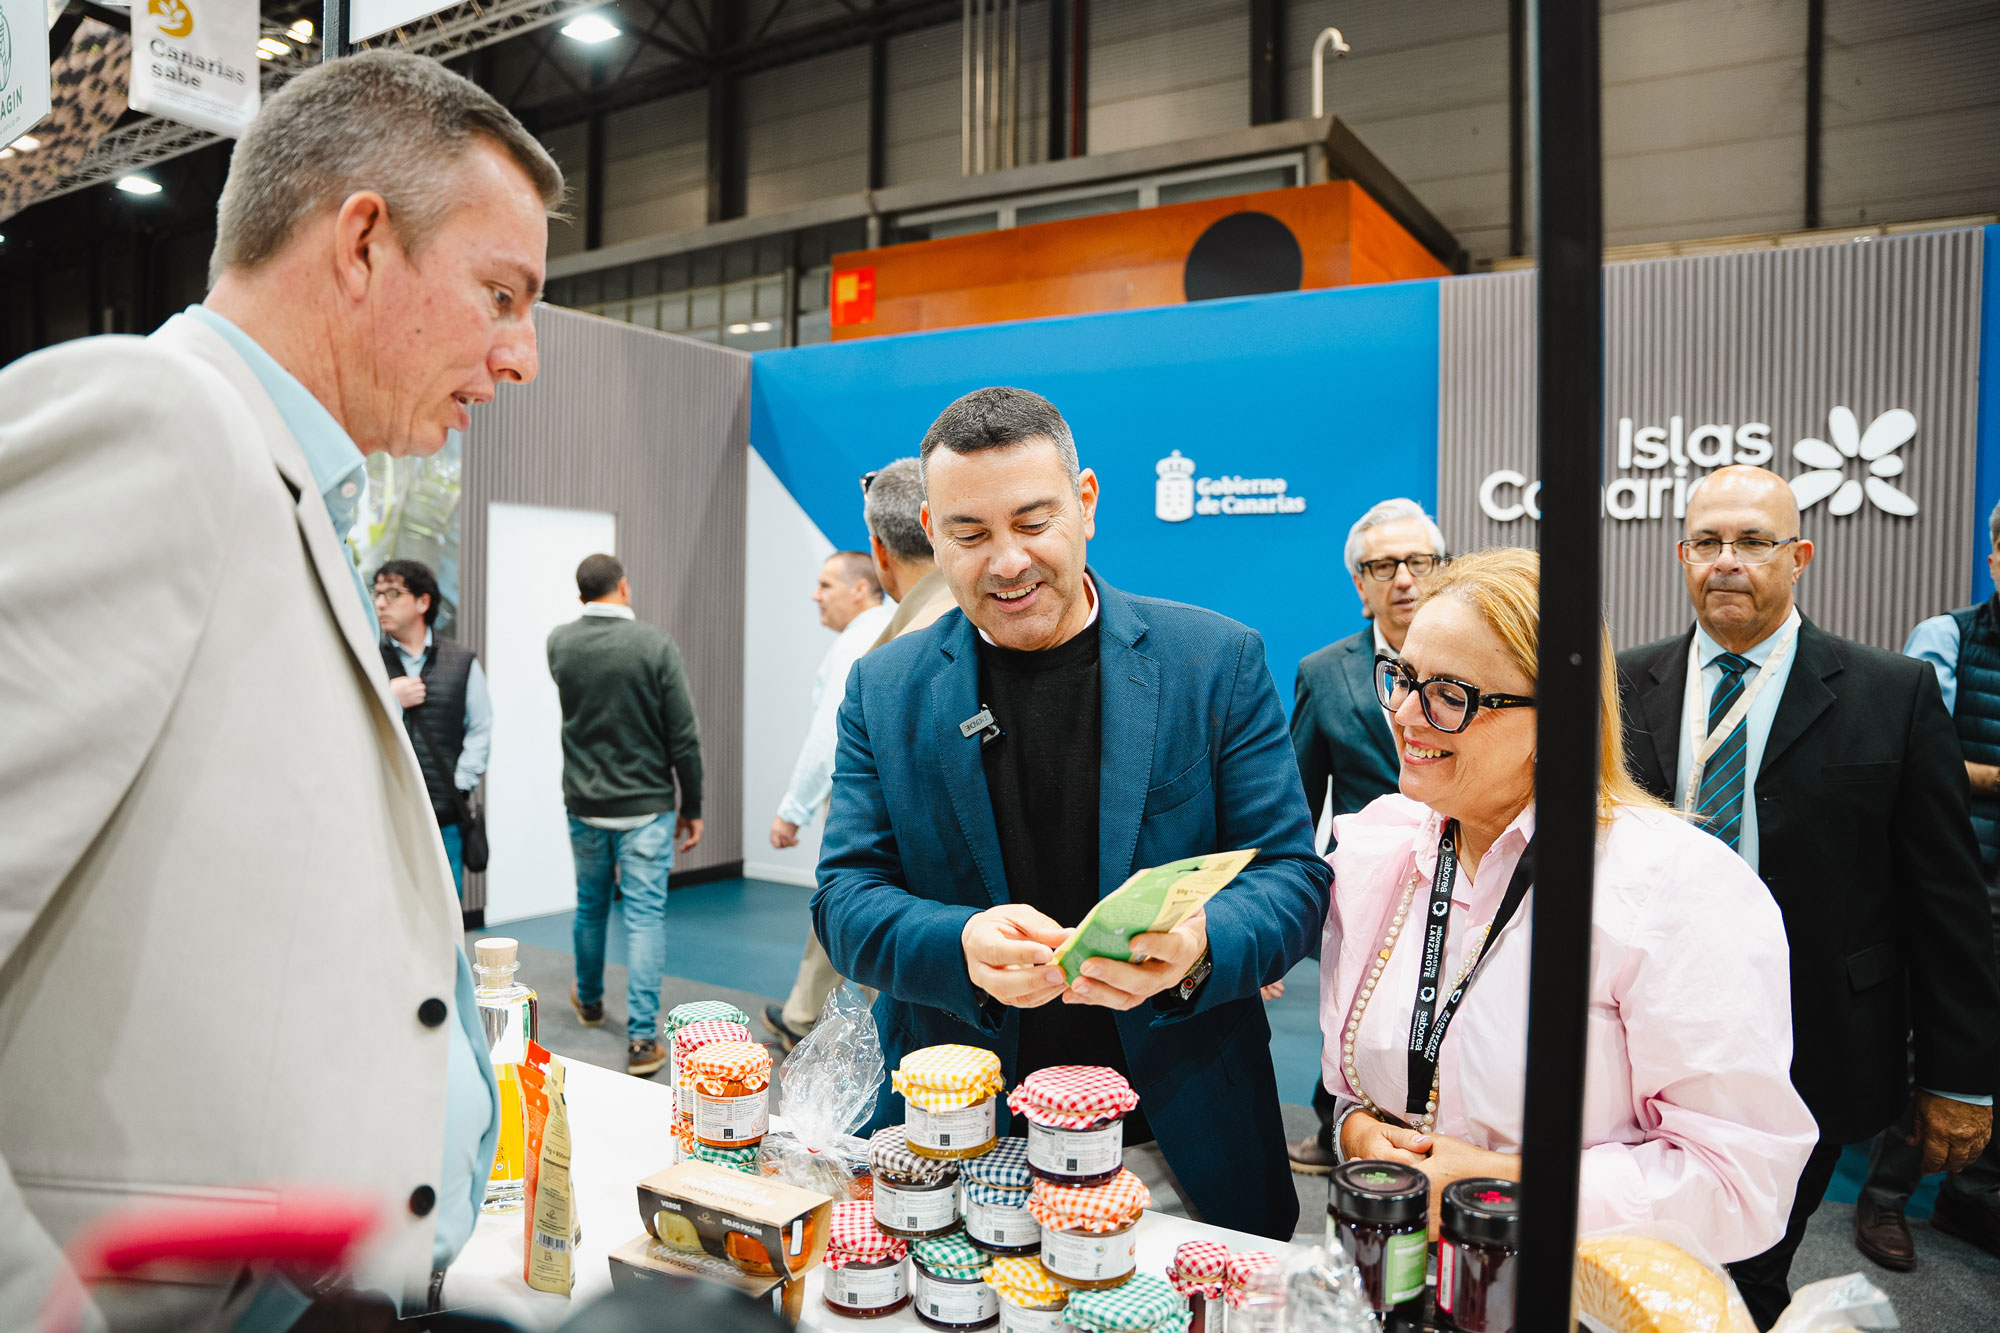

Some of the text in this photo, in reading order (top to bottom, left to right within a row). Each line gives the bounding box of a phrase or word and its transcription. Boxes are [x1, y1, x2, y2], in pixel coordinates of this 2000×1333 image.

[150, 39, 246, 86] Canarias
[152, 63, 202, 89] sabe
[1617, 416, 1774, 470] Islas
[1196, 475, 1288, 496] Gobierno
[1195, 493, 1307, 515] de Canarias
[1440, 856, 1453, 893] saborea
[1423, 924, 1438, 978] LANZAROTE
[1414, 1010, 1428, 1051] saborea
[1428, 1012, 1452, 1063] LANZAROTE
[660, 1200, 682, 1211] VERDE
[721, 1218, 741, 1230] ROJO
[654, 1254, 697, 1271] CANARIO
